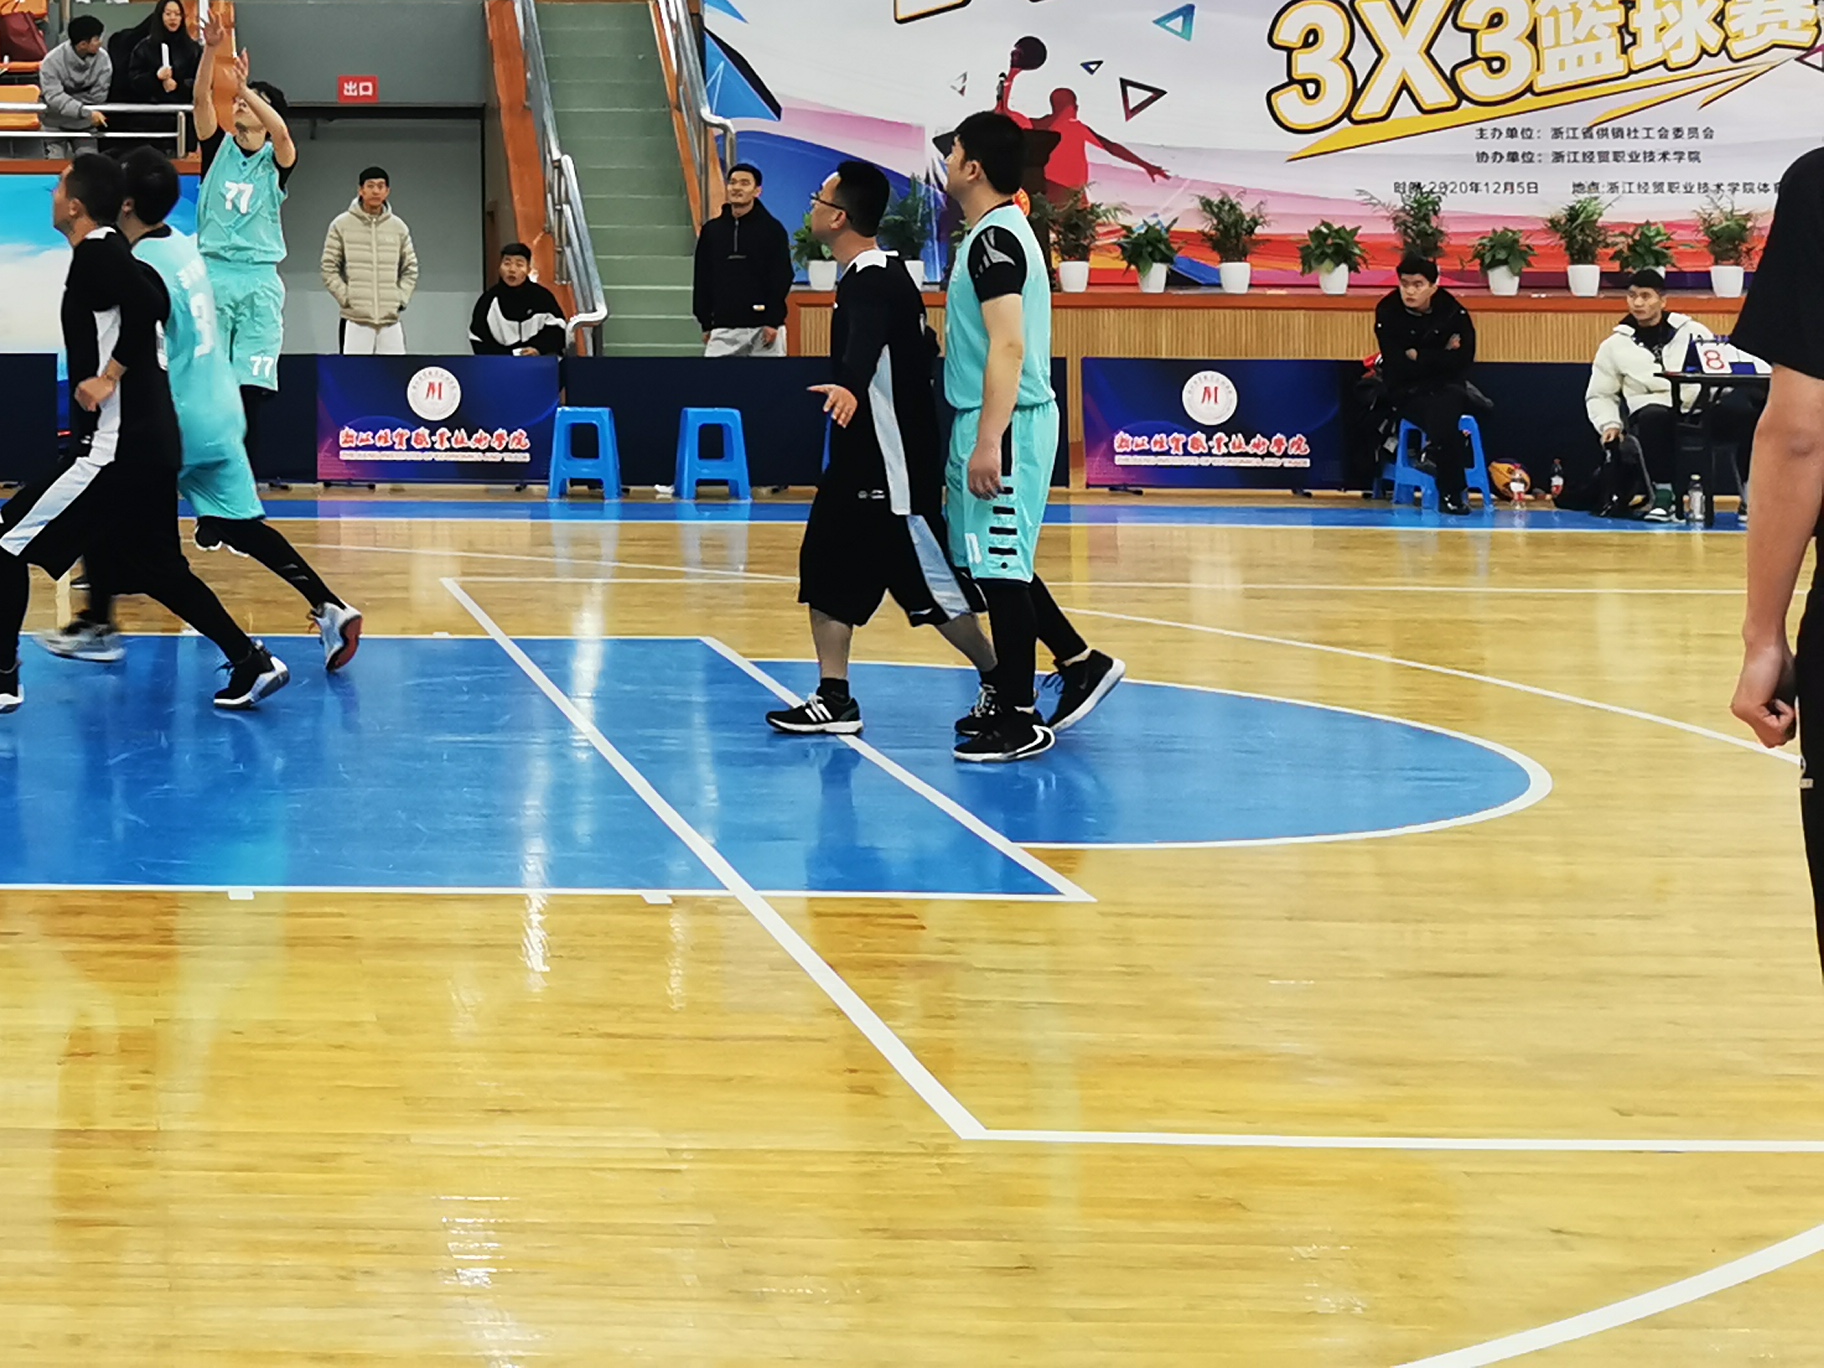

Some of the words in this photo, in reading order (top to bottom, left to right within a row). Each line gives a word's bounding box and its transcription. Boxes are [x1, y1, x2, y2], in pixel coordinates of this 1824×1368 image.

[343, 80, 374, 96] 出口
[225, 180, 254, 214] 77
[250, 355, 274, 377] 77
[1703, 349, 1725, 370] 8
